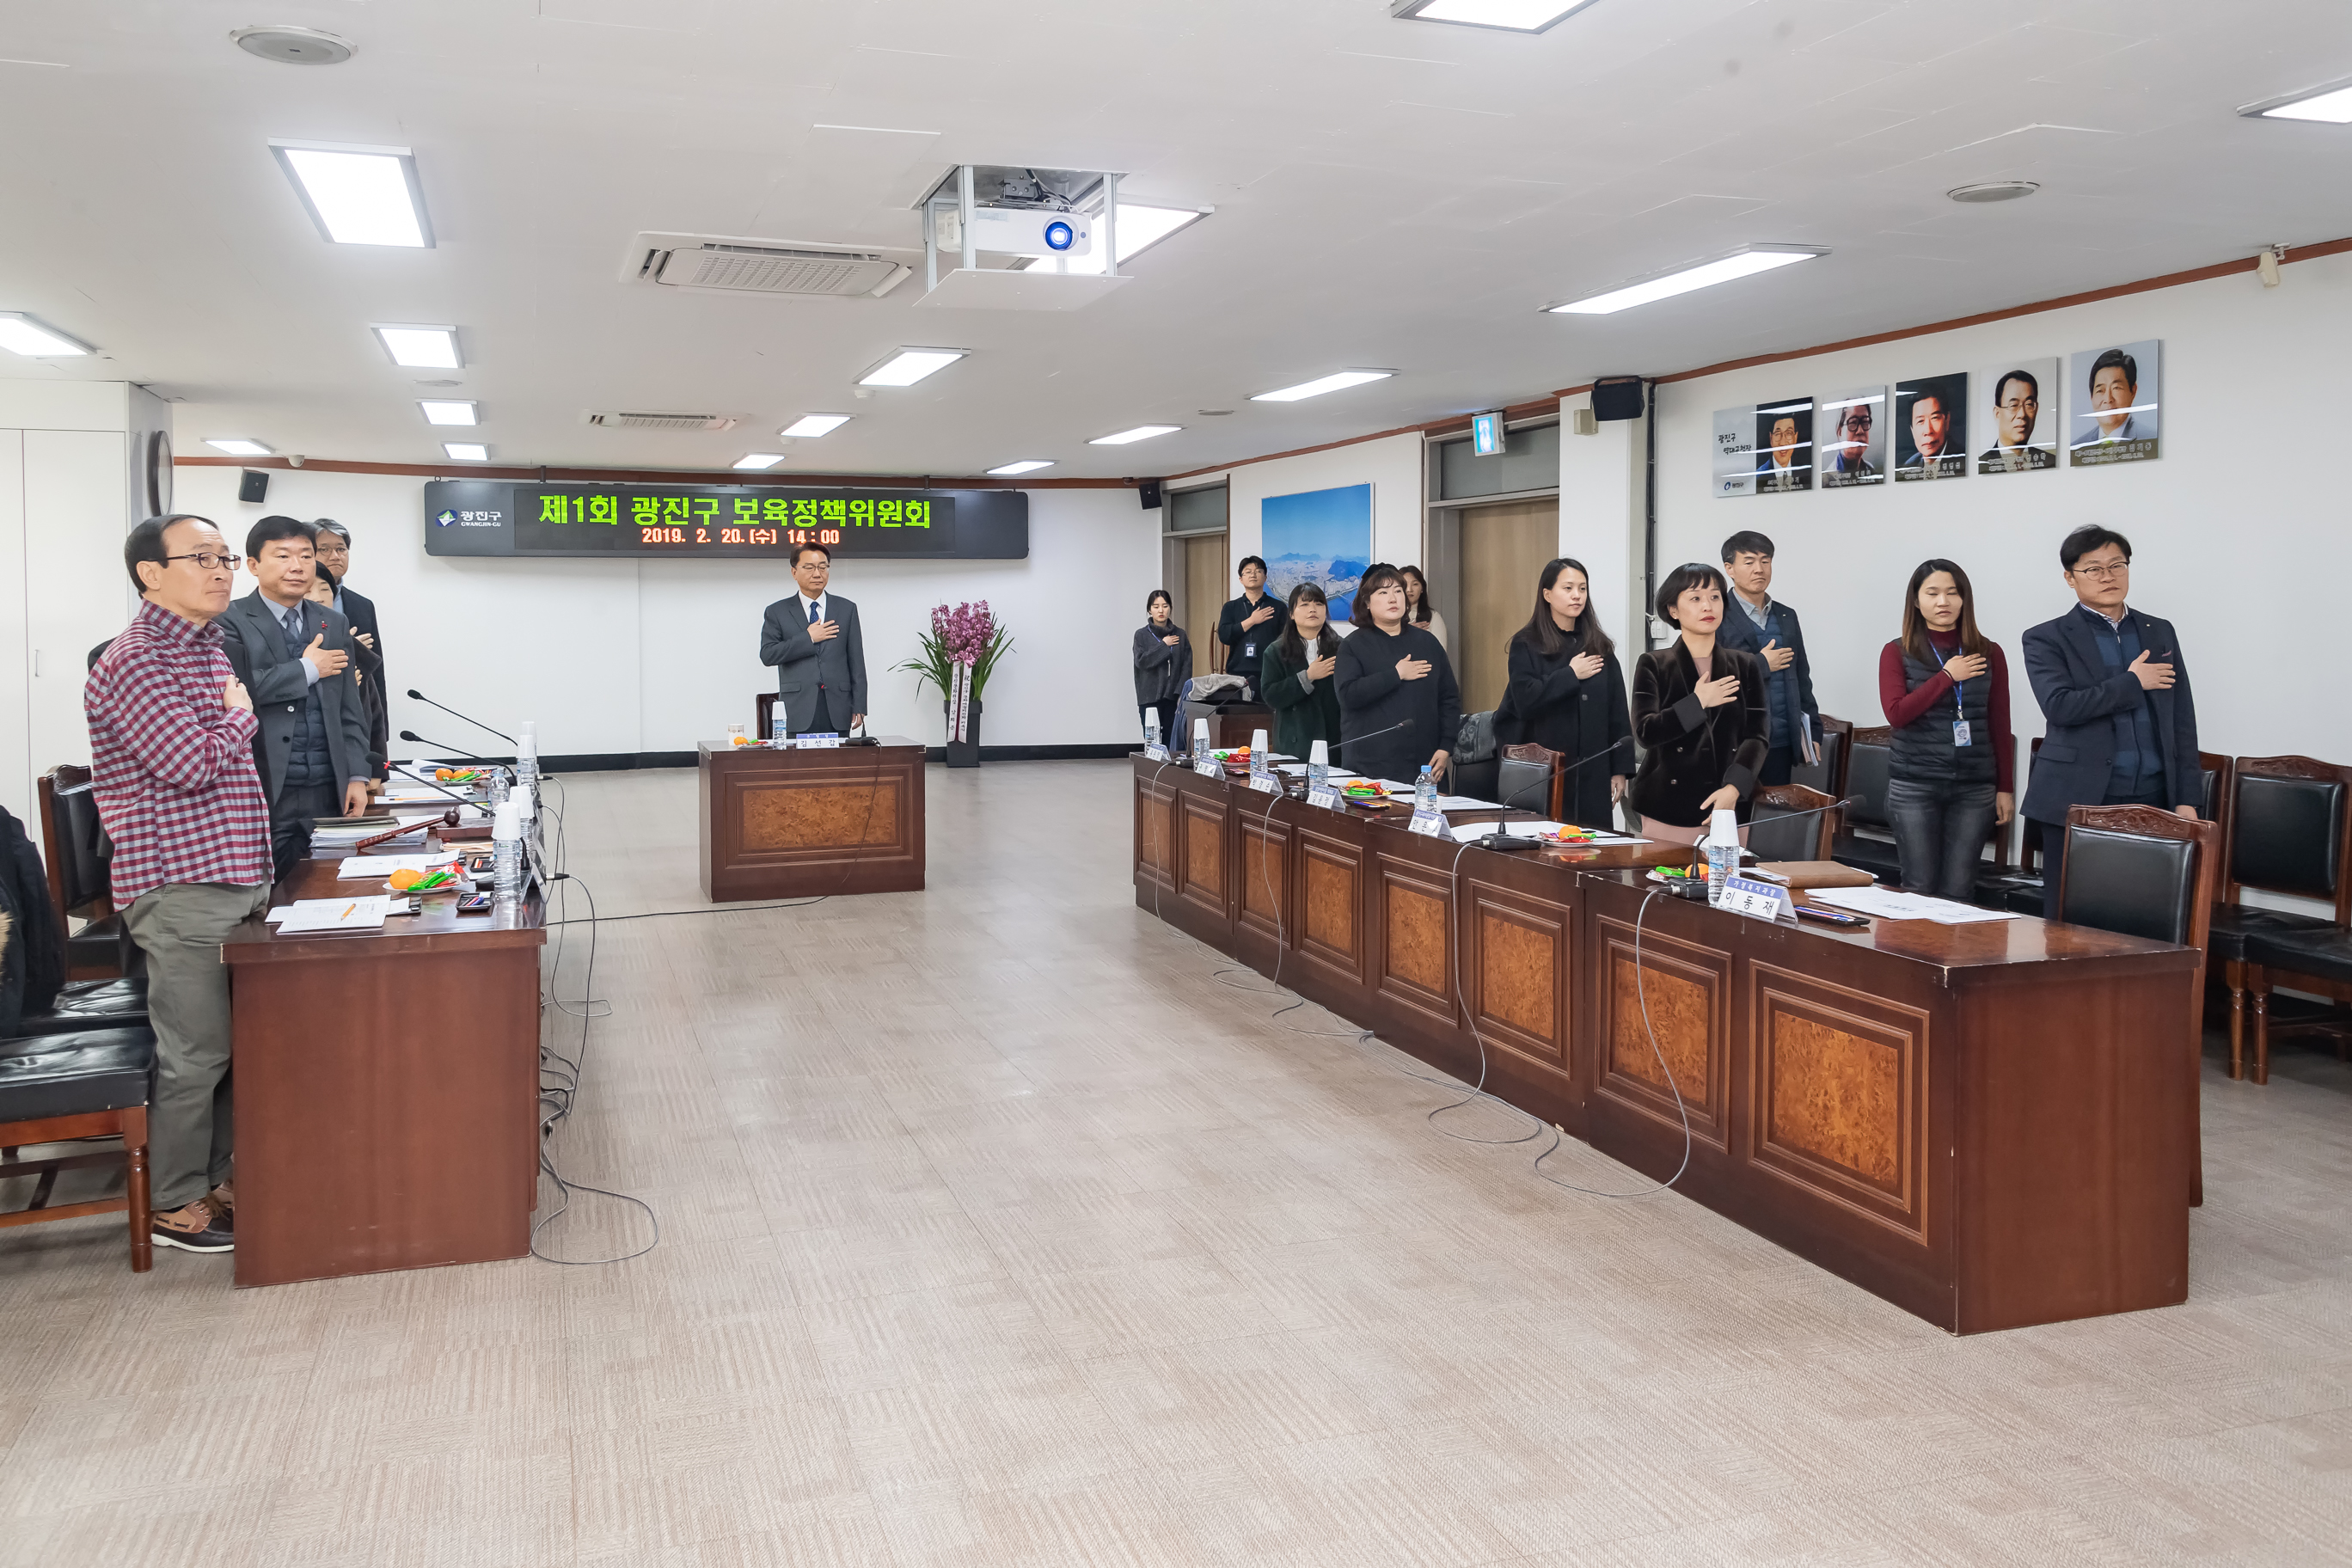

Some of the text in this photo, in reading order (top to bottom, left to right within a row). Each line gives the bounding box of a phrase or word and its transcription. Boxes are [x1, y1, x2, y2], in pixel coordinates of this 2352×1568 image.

[1718, 432, 1736, 444] 광진구
[460, 510, 503, 521] 광진구
[538, 494, 931, 529] 제1회 광진구 보육정책위원회
[641, 527, 687, 543] 2019.
[695, 528, 712, 543] 2.
[1733, 879, 1777, 897] 가정복지과장
